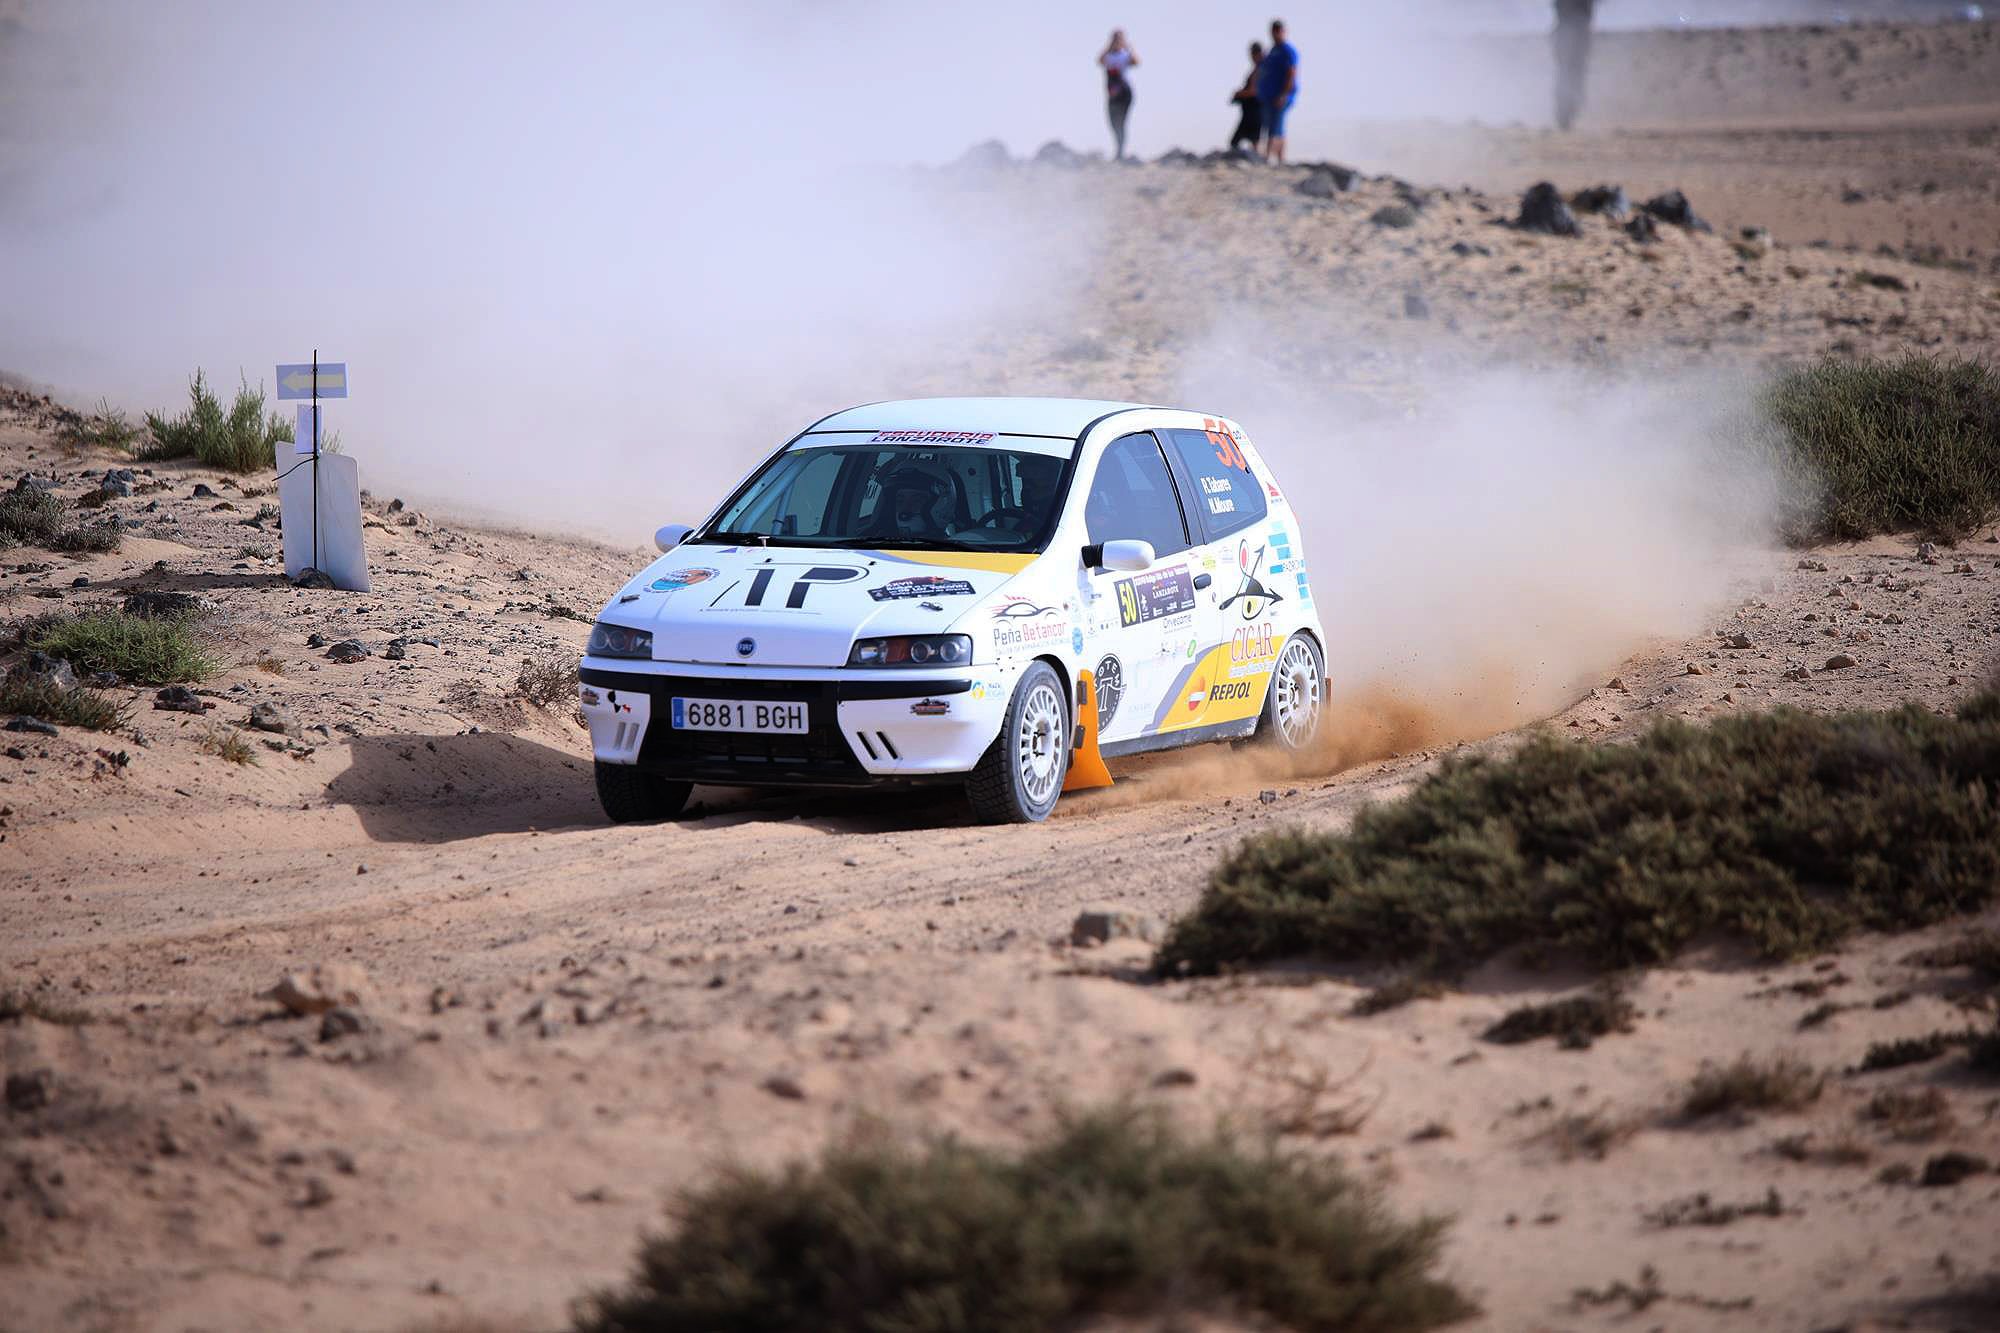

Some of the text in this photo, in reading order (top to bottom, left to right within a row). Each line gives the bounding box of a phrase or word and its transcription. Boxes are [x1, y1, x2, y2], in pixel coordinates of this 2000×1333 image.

[871, 436, 988, 445] LANZAROTE
[1203, 418, 1246, 472] 50
[1118, 581, 1138, 625] 50
[993, 628, 1022, 647] Peña
[1231, 622, 1274, 662] CICAR
[1209, 681, 1252, 701] REPSOL
[687, 703, 803, 729] 6881 BGH
